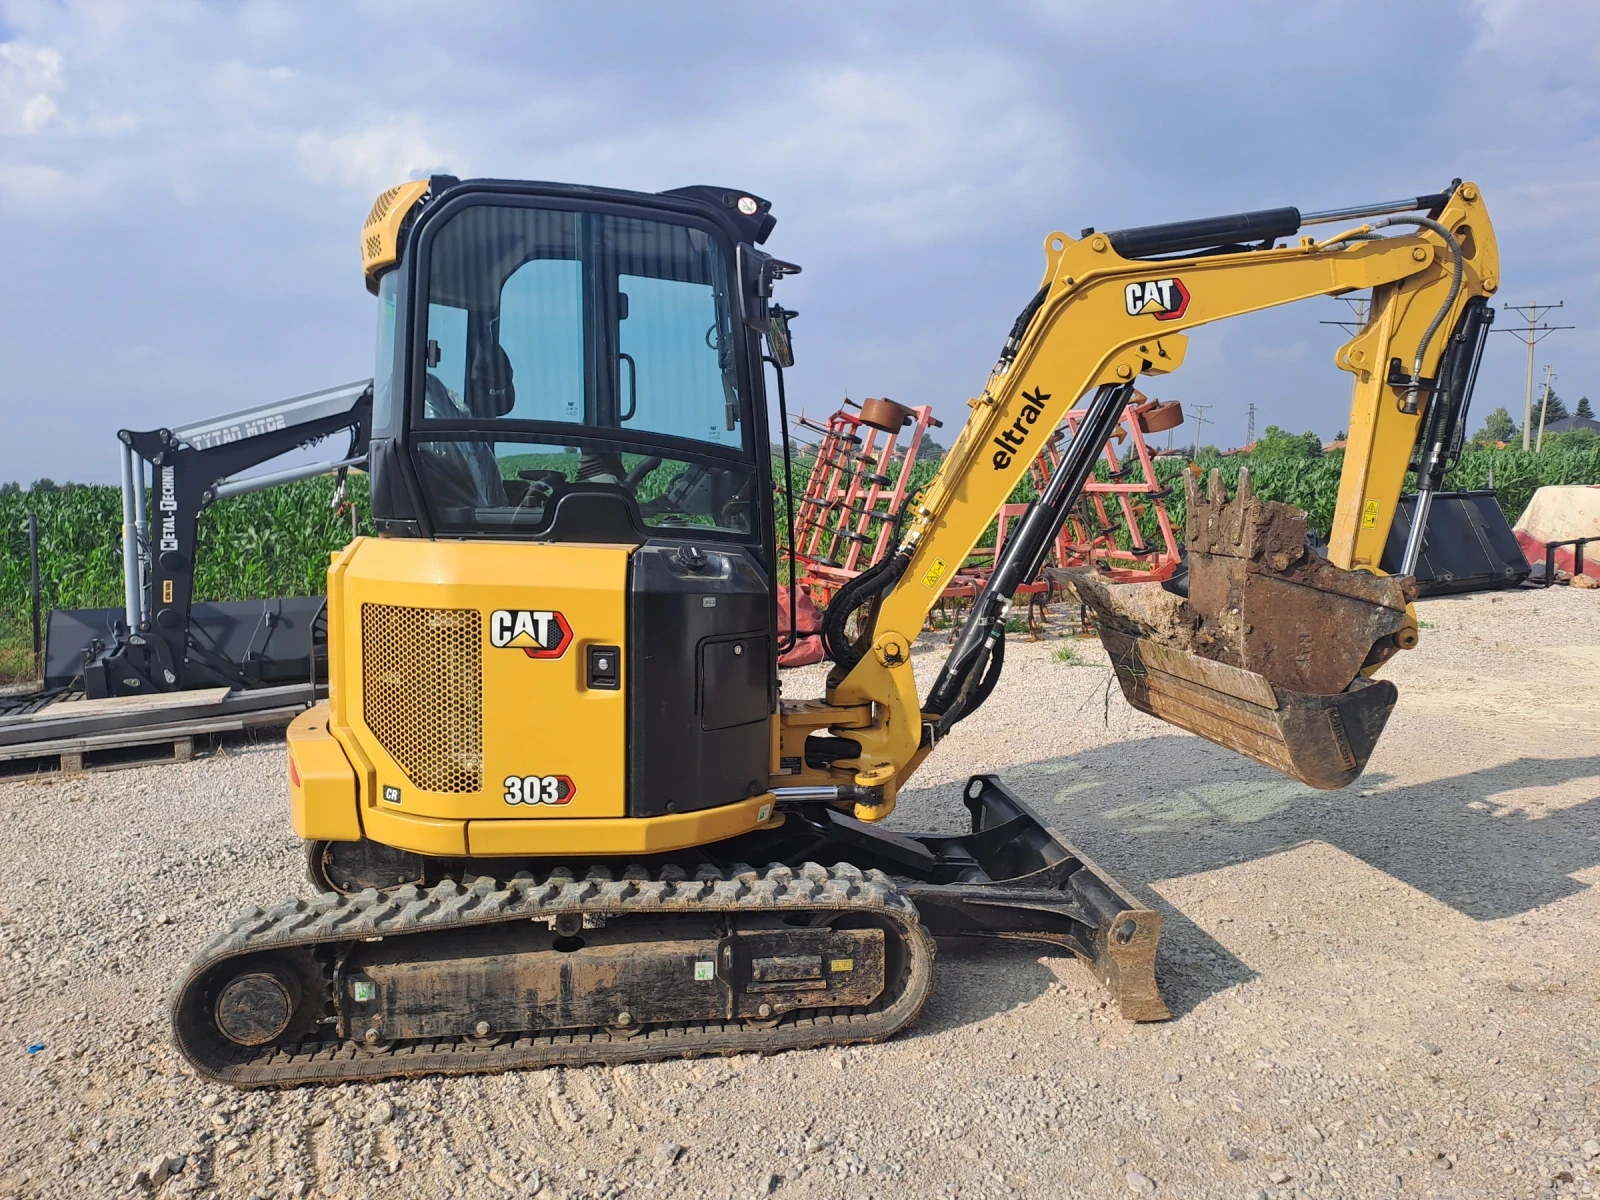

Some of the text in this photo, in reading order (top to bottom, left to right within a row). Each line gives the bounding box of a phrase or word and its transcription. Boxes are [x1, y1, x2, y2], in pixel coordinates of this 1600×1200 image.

[1125, 279, 1174, 315] CAT
[993, 385, 1052, 471] eltrak
[160, 465, 178, 551] METAL-TECHNIK
[491, 610, 553, 648] CAT
[386, 788, 398, 801] CR
[504, 776, 559, 804] 303
